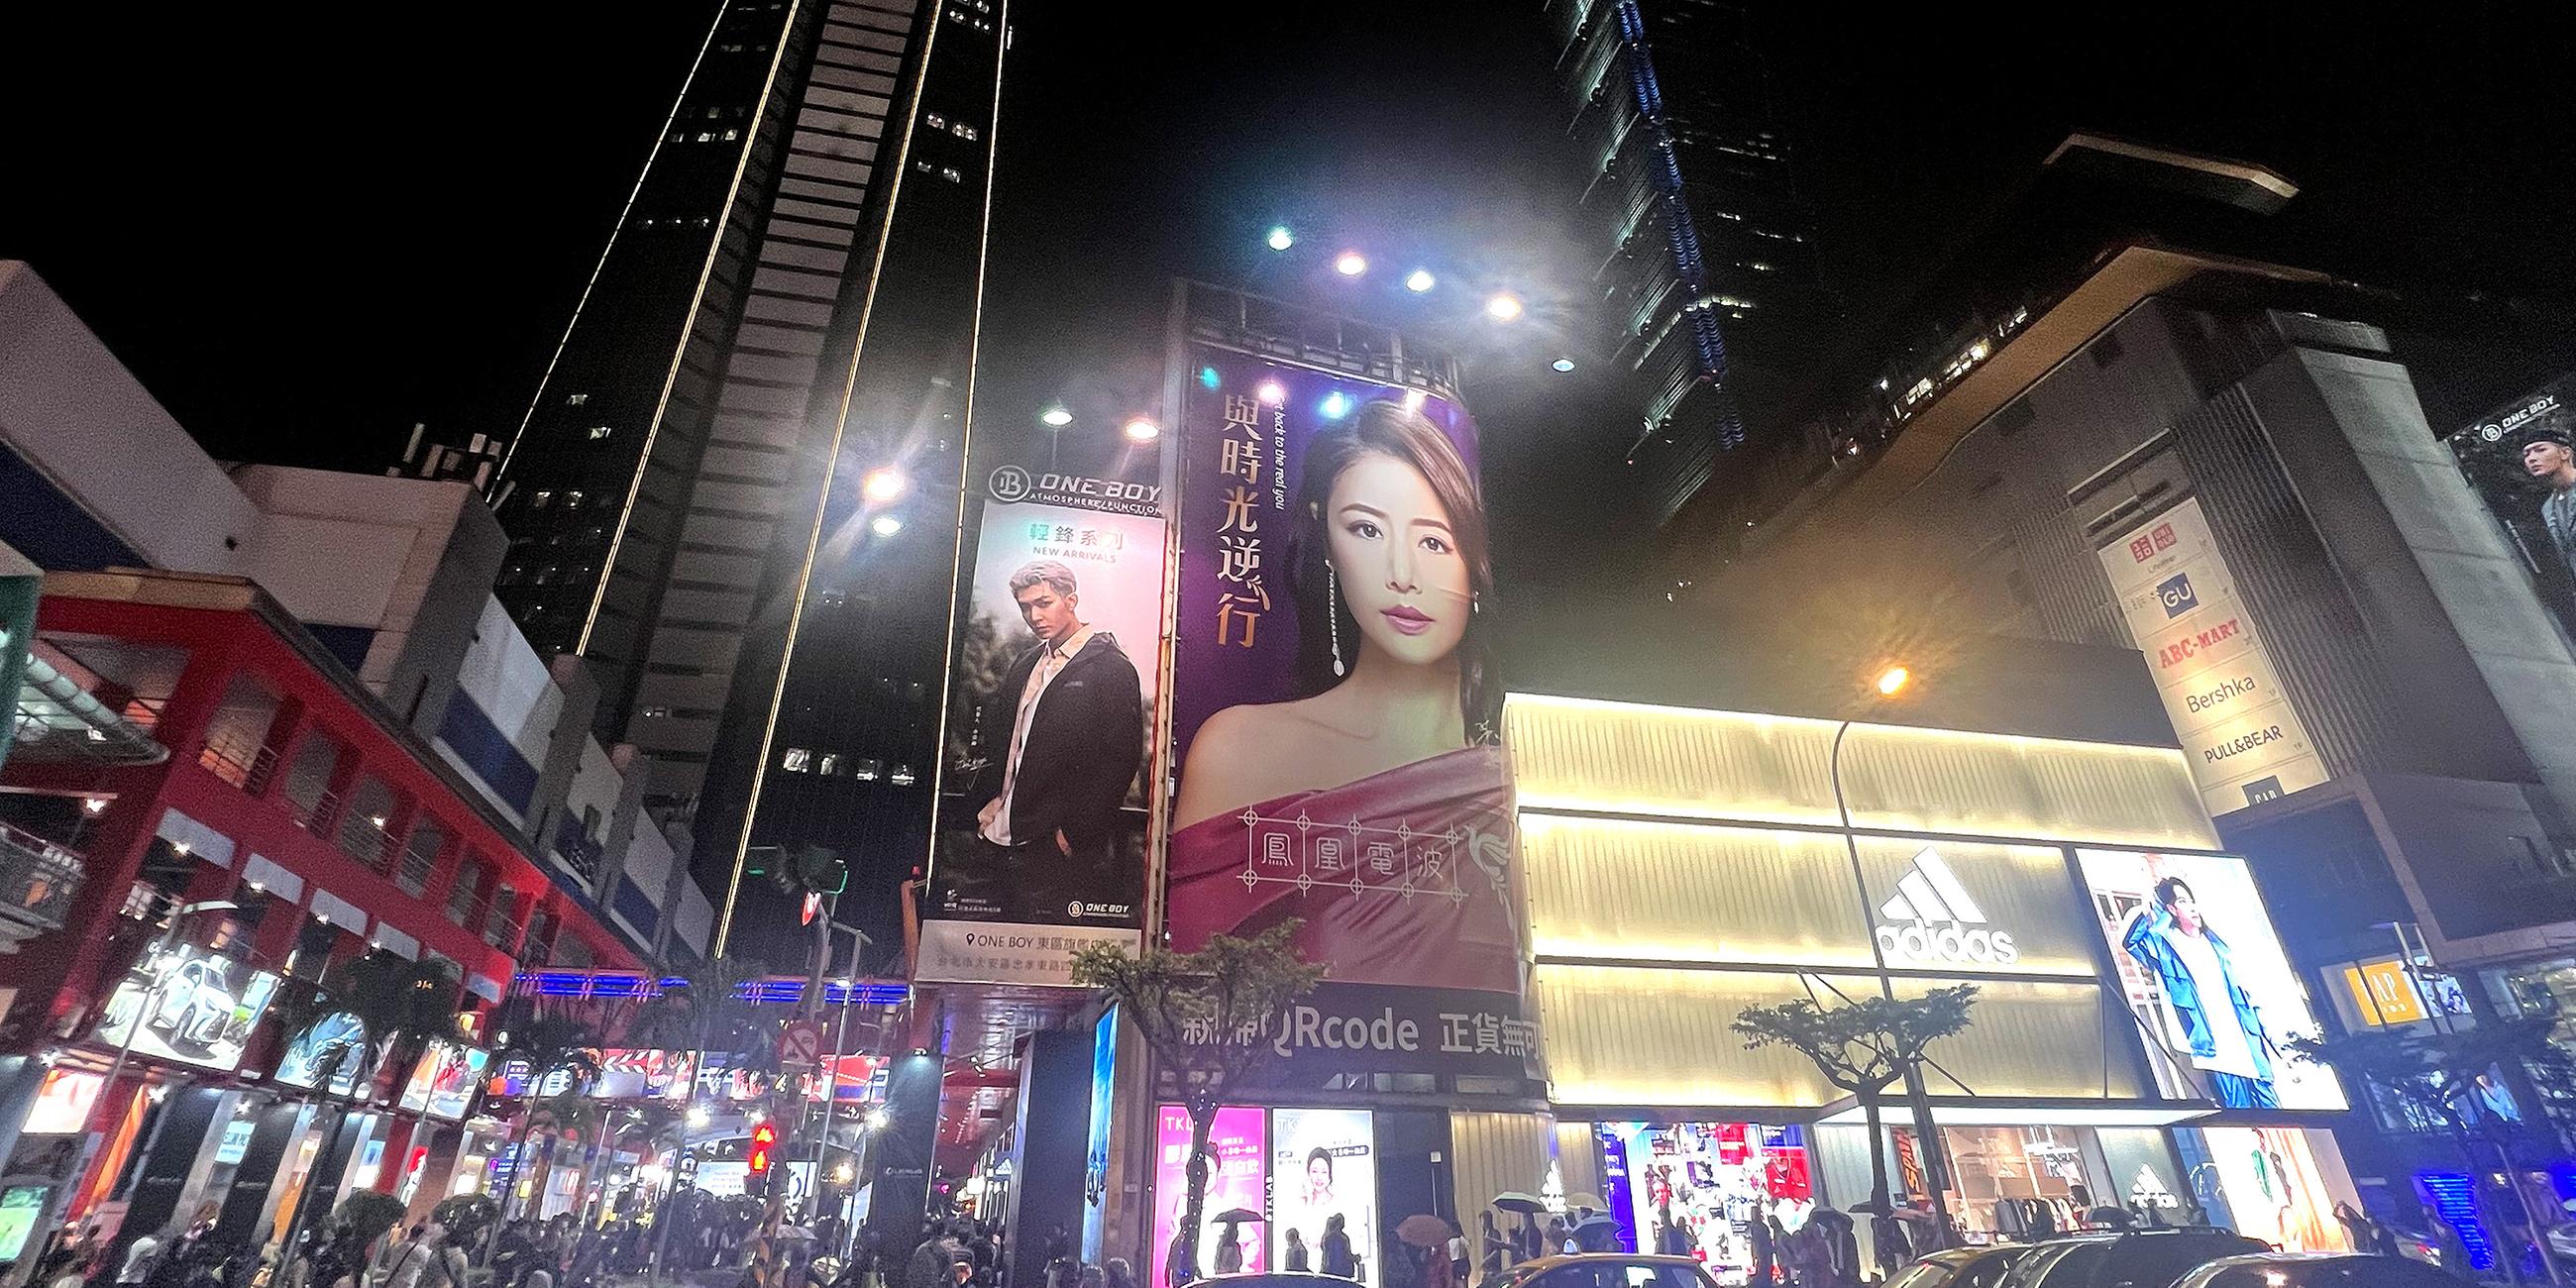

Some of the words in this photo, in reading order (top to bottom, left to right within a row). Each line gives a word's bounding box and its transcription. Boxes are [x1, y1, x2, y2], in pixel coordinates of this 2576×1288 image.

[1274, 409, 1287, 434] back
[2502, 407, 2529, 428] ONE
[2527, 394, 2555, 415] BOY
[1275, 436, 1285, 447] to
[1275, 449, 1287, 467] the
[1039, 473, 1101, 494] ONE
[1105, 481, 1162, 501] BOY
[1275, 467, 1288, 488] real
[1272, 487, 1285, 510] you
[1217, 394, 1263, 648] 與時光逆行
[1032, 546, 1059, 556] NEW
[1062, 549, 1116, 564] ARRIVALS
[2163, 583, 2193, 607] GU
[2159, 617, 2241, 669] ABC-MART
[2186, 676, 2257, 713] Bershka
[2203, 724, 2285, 765] PULL&BEAR
[1261, 832, 1444, 880] 鳳凰電波
[1086, 903, 1109, 913] ONE
[1108, 904, 1130, 913] BOY
[977, 934, 1005, 948] ONE
[1008, 936, 1034, 949] BOY
[1875, 917, 2020, 965] adidas
[1260, 1005, 1420, 1058] QRcode
